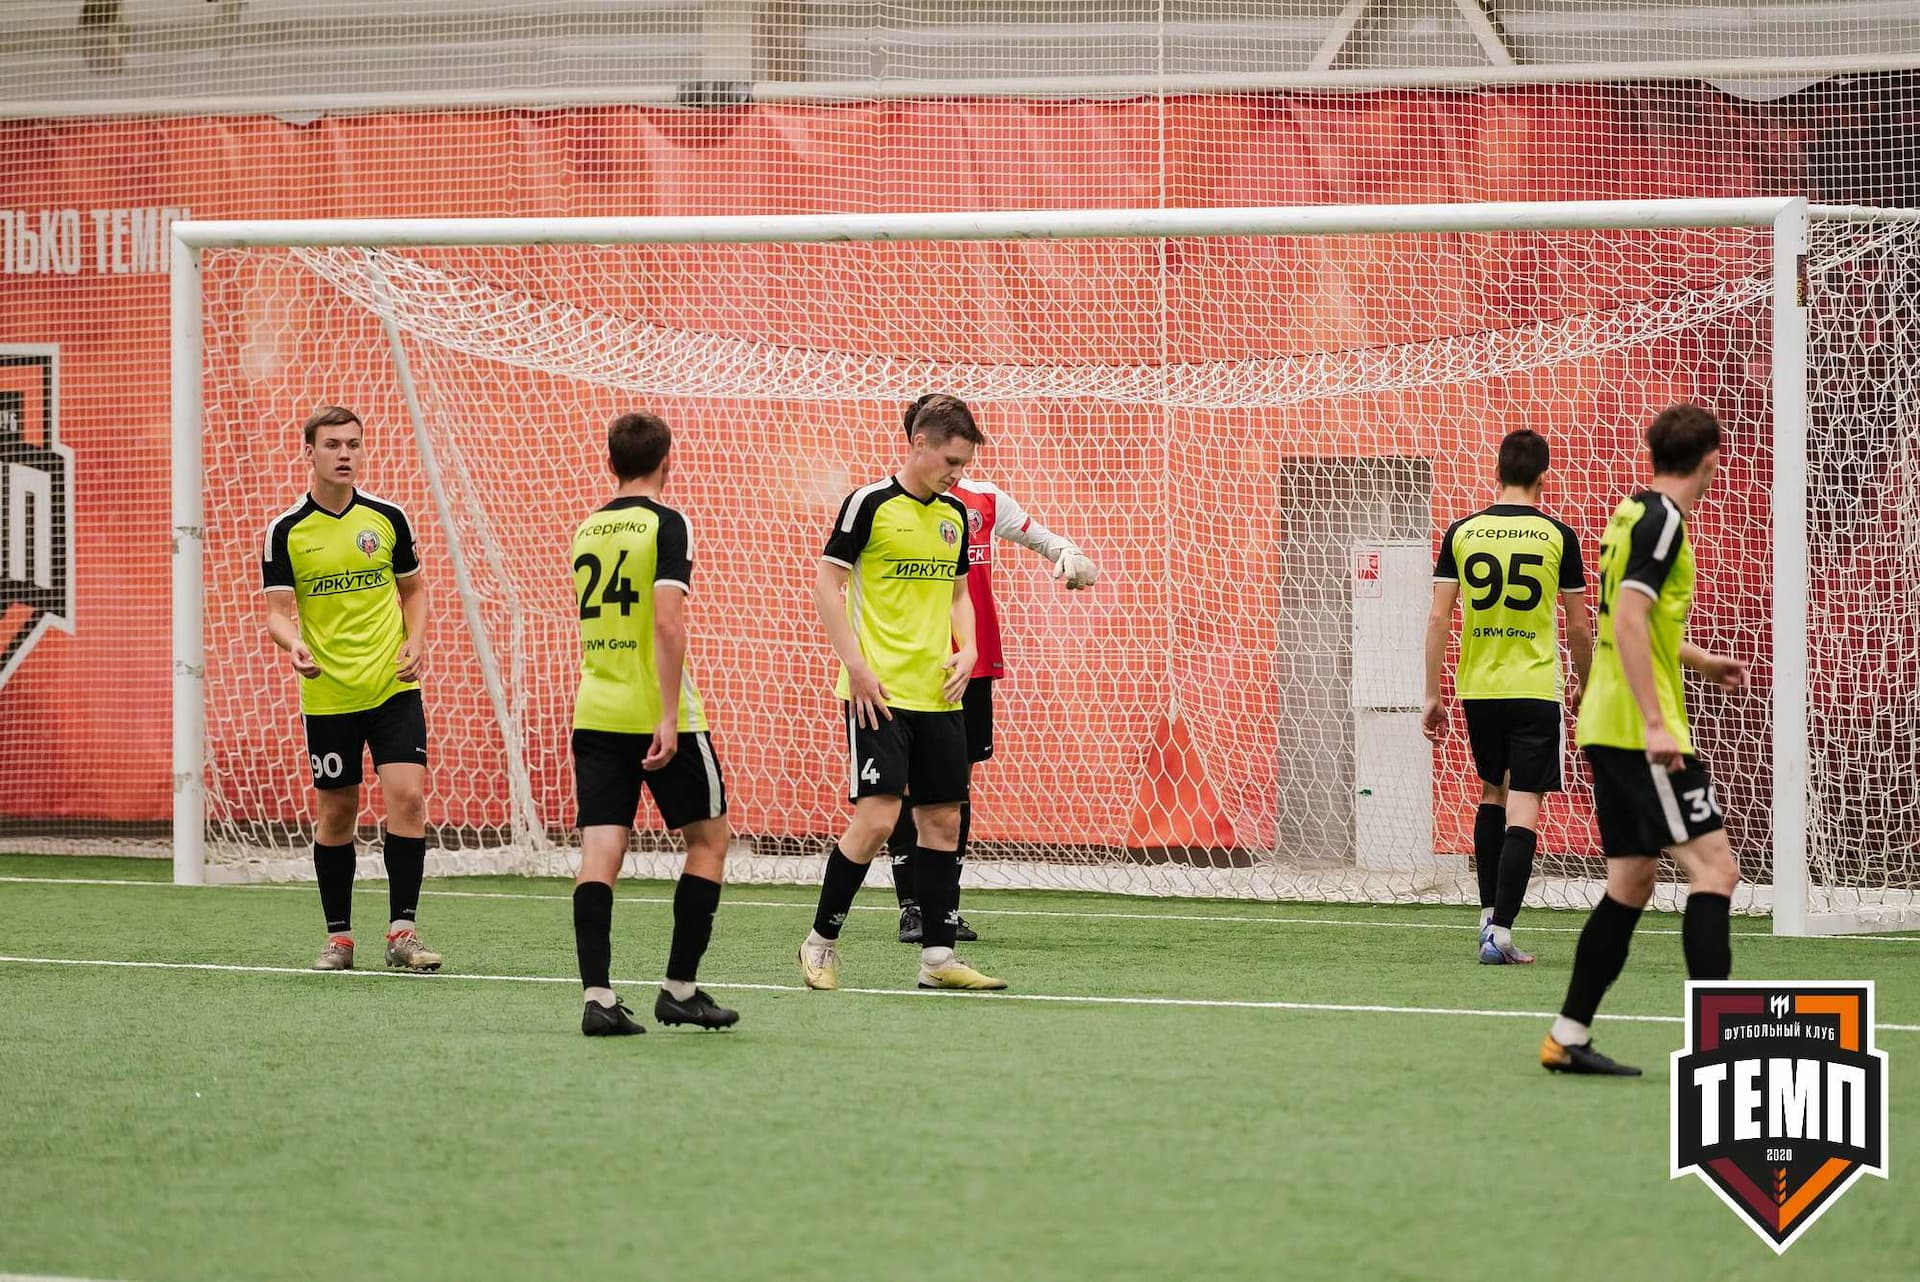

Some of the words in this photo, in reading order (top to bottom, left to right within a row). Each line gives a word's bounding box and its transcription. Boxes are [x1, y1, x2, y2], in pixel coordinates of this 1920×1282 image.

[1476, 528, 1550, 541] сервико
[312, 570, 384, 594] ИРКУТСК
[574, 550, 640, 620] 24
[1464, 552, 1544, 611] 95
[1483, 627, 1504, 638] RVM
[1506, 627, 1536, 641] Group
[311, 752, 343, 778] 90
[861, 757, 881, 785] 4
